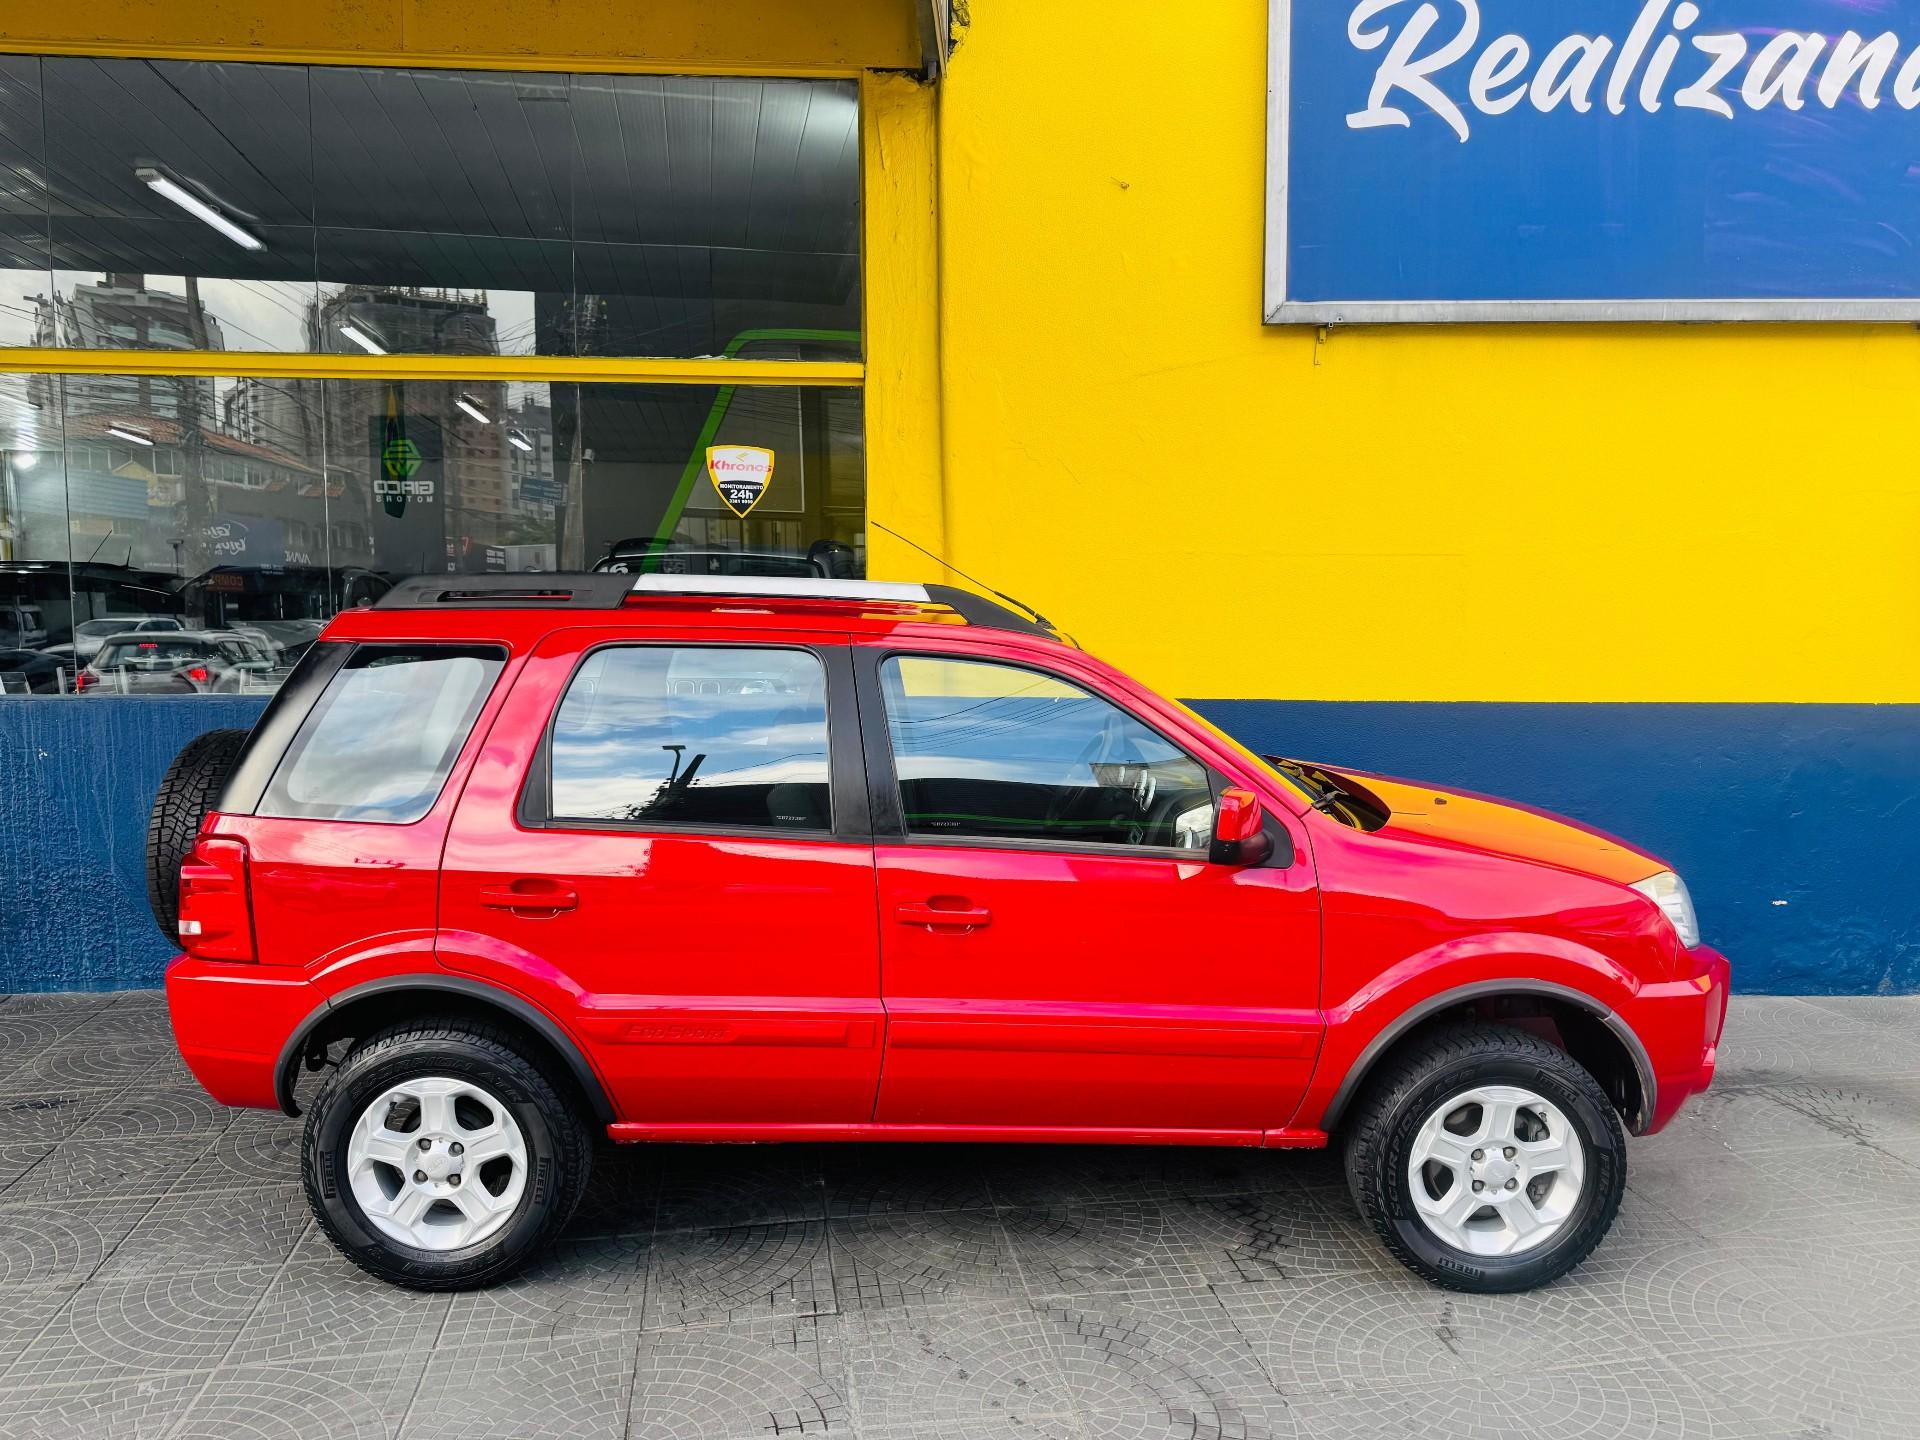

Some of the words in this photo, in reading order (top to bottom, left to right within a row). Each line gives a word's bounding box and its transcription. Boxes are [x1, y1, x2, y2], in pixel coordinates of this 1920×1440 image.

[710, 460, 772, 472] Khronos
[730, 489, 754, 499] 24h
[320, 1151, 337, 1199] PIRELLI
[1386, 1098, 1425, 1217] SCORPION
[534, 1157, 552, 1205] PIRELLI
[1438, 1257, 1486, 1281] PIRELLI
